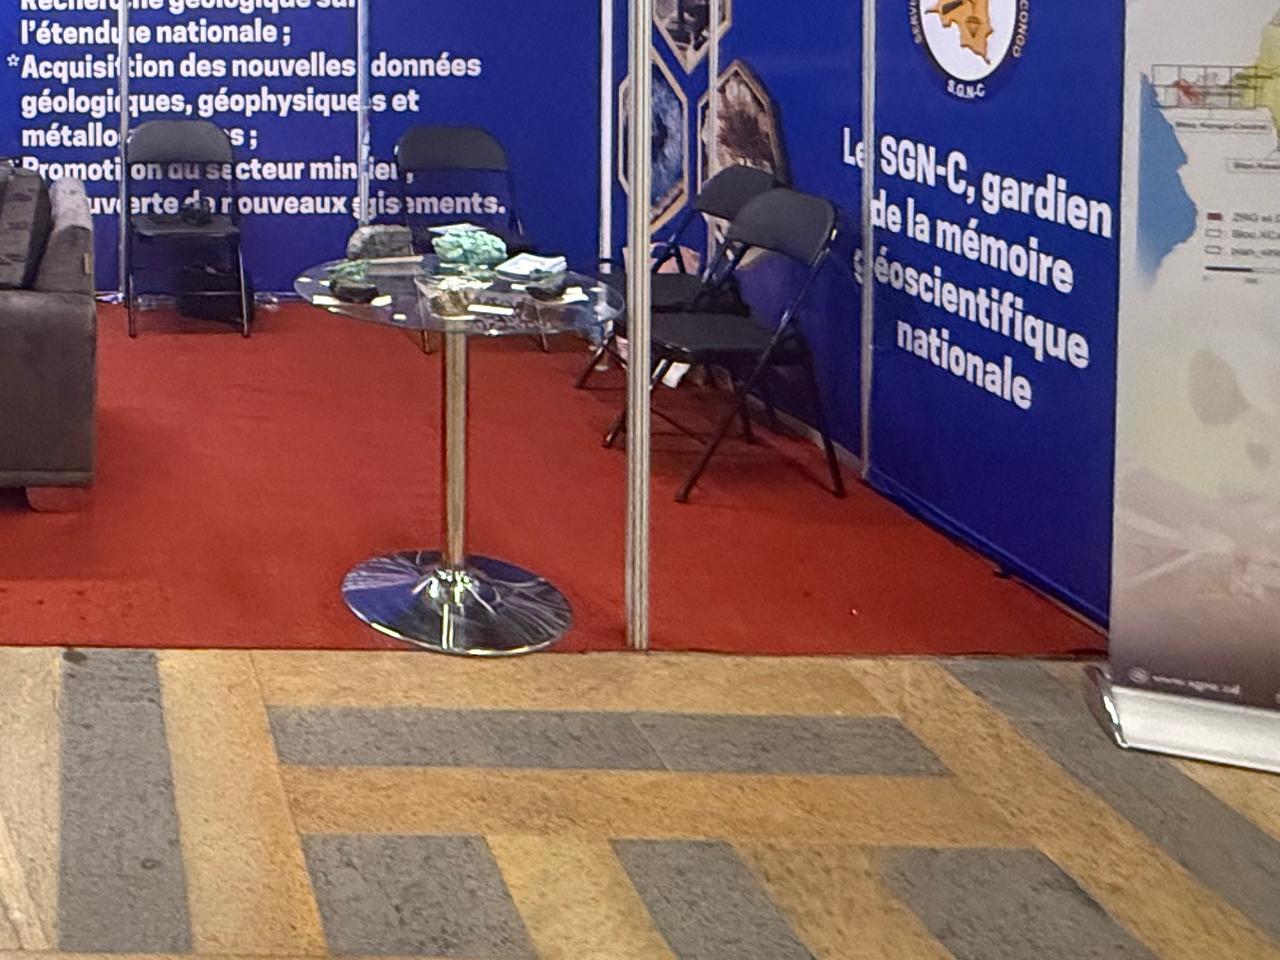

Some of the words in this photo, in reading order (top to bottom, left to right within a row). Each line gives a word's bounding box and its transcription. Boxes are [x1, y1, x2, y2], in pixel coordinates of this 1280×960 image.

[156, 17, 278, 43] nationale
[179, 52, 227, 78] des
[231, 51, 357, 77] nouvelles
[370, 51, 482, 77] données
[21, 88, 193, 119] géologiques,
[197, 86, 387, 117] géophysiques
[391, 89, 420, 112] et
[206, 158, 304, 180] secteur
[843, 126, 865, 169] Le
[880, 134, 976, 205] SGN-C,
[981, 171, 1113, 239] gardien
[870, 188, 902, 233] de
[906, 197, 931, 244] la
[935, 217, 1075, 294] mémoire
[896, 319, 1033, 411] nationale
